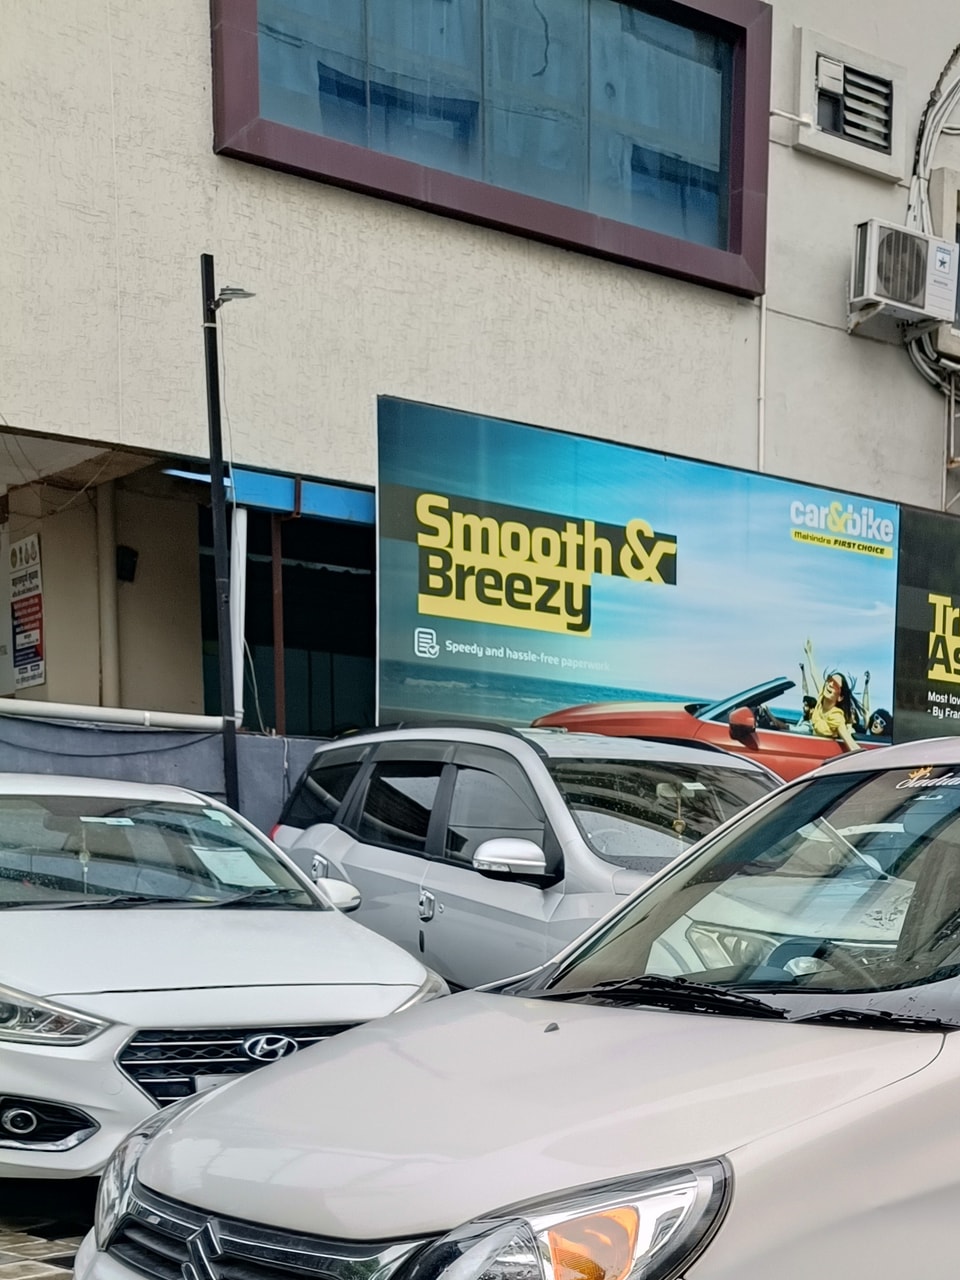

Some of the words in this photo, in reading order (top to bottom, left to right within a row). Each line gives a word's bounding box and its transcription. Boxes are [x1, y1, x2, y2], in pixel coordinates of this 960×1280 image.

[790, 501, 894, 542] car&bike
[416, 493, 612, 575] Smooth
[619, 519, 676, 584] &
[833, 539, 856, 550] FIRST
[857, 543, 885, 555] CHOICE
[418, 545, 592, 632] Breezy
[445, 640, 483, 658] Speedy
[485, 647, 504, 658] and
[506, 650, 560, 665] hassle-free
[927, 691, 948, 703] Most
[932, 706, 943, 719] By
